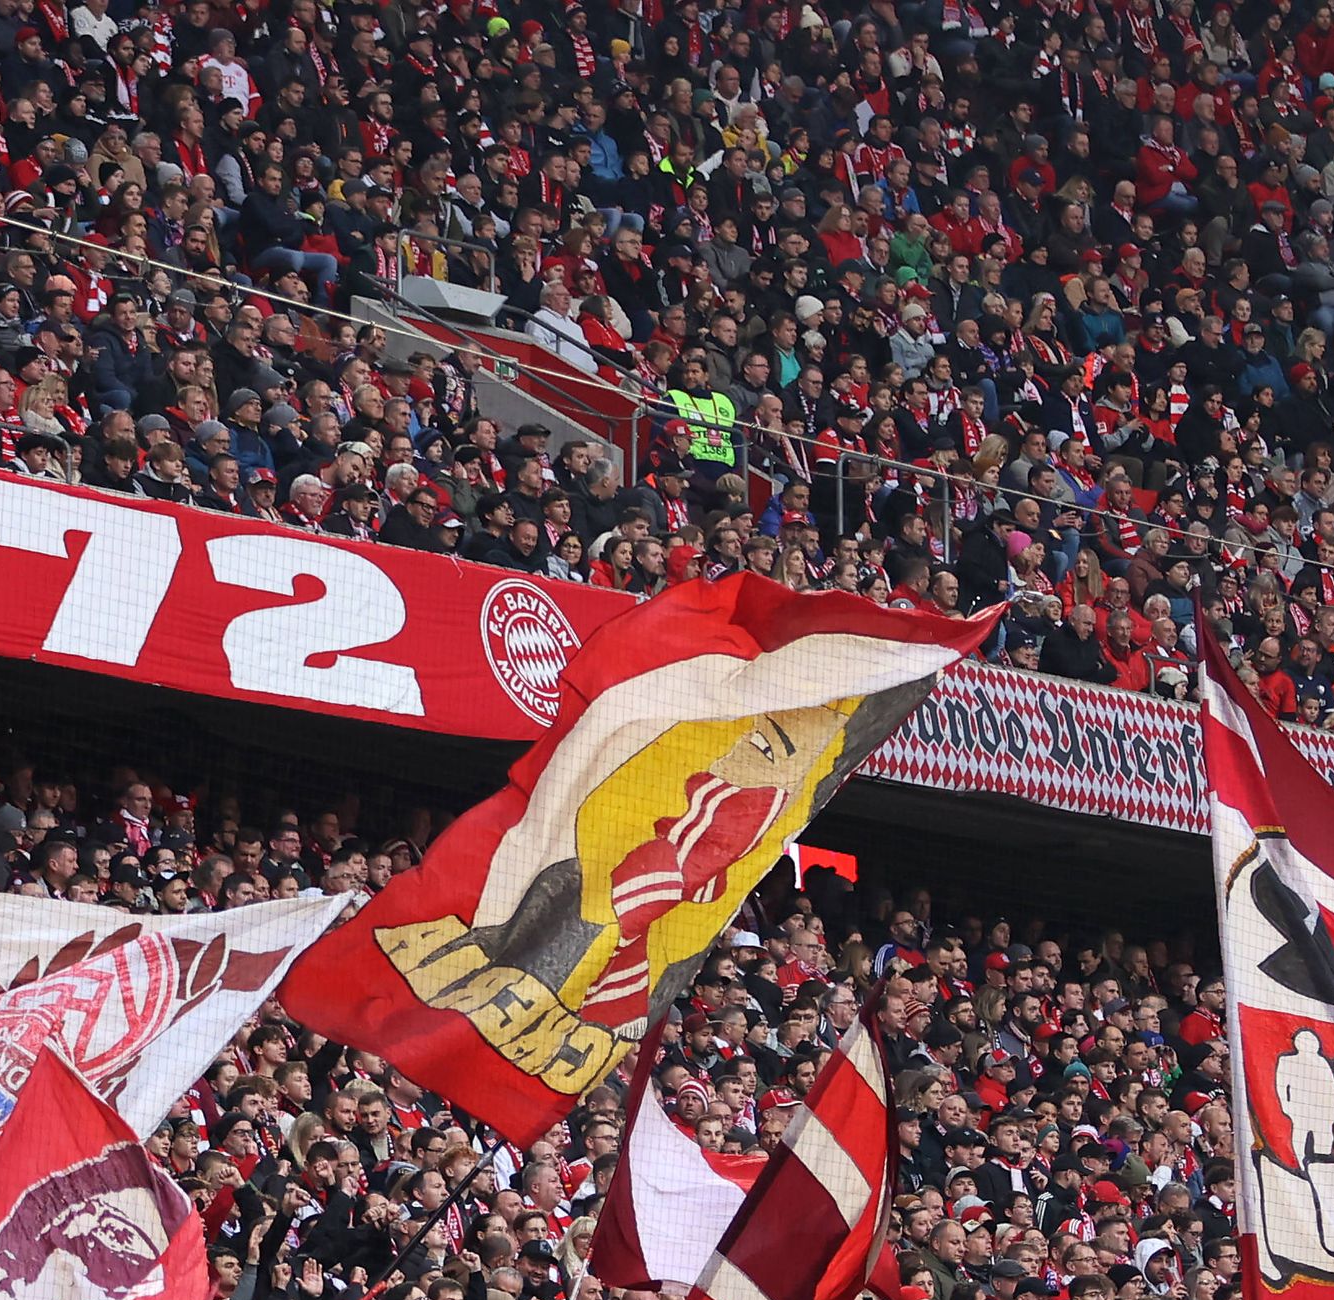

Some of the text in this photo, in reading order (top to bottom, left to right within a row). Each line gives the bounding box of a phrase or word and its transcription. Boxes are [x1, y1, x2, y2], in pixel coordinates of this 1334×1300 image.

[505, 591, 574, 648] BAYERN
[897, 687, 1200, 813] ando Unterf
